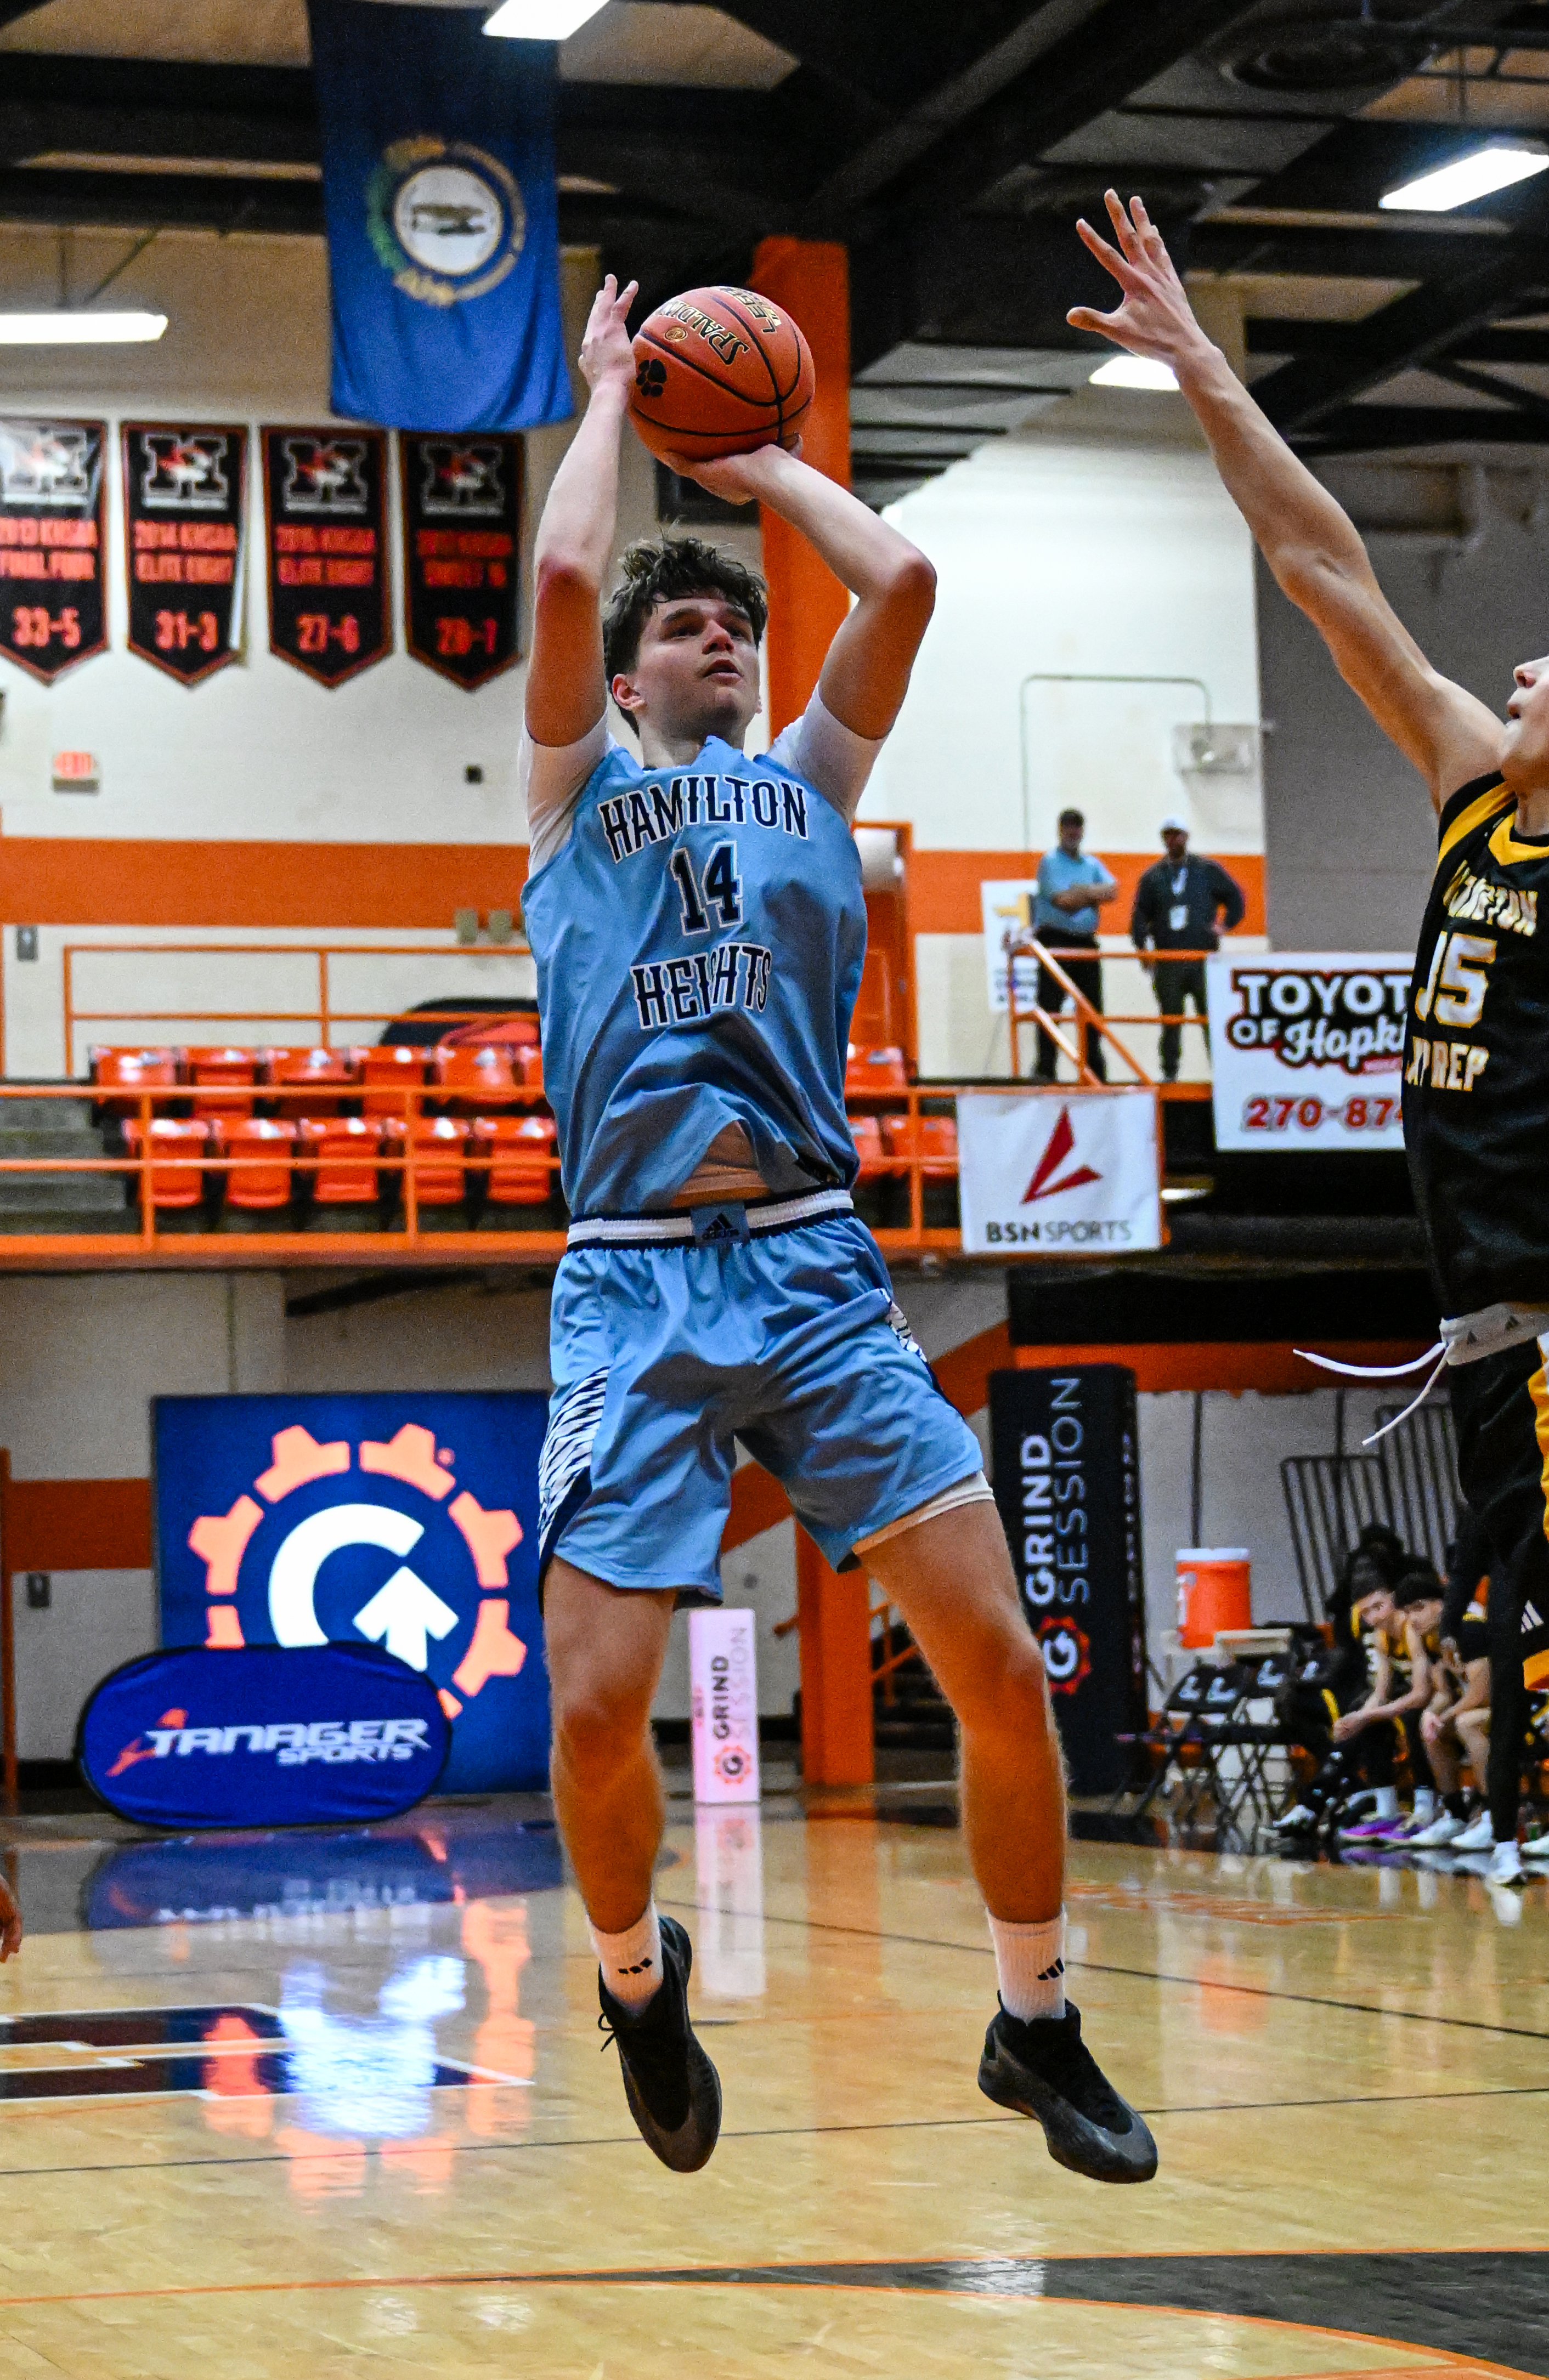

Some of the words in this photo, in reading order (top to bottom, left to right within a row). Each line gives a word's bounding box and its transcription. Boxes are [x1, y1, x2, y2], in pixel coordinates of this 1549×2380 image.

[652, 299, 750, 365] SPALDIN
[597, 774, 809, 864] HAMILTON
[670, 841, 744, 936] 14
[630, 942, 772, 1030] HEIHTS
[1232, 1018, 1280, 1044] OF
[1246, 1098, 1403, 1127] 270-87
[986, 1221, 1040, 1243] BSN
[1044, 1220, 1132, 1243] SPORTS
[1020, 1434, 1055, 1605] GRIND
[1051, 1378, 1090, 1605] SESSION
[711, 1655, 730, 1740] GRIND
[146, 1718, 432, 1758] TANAGER
[277, 1744, 414, 1766] SPORTS
